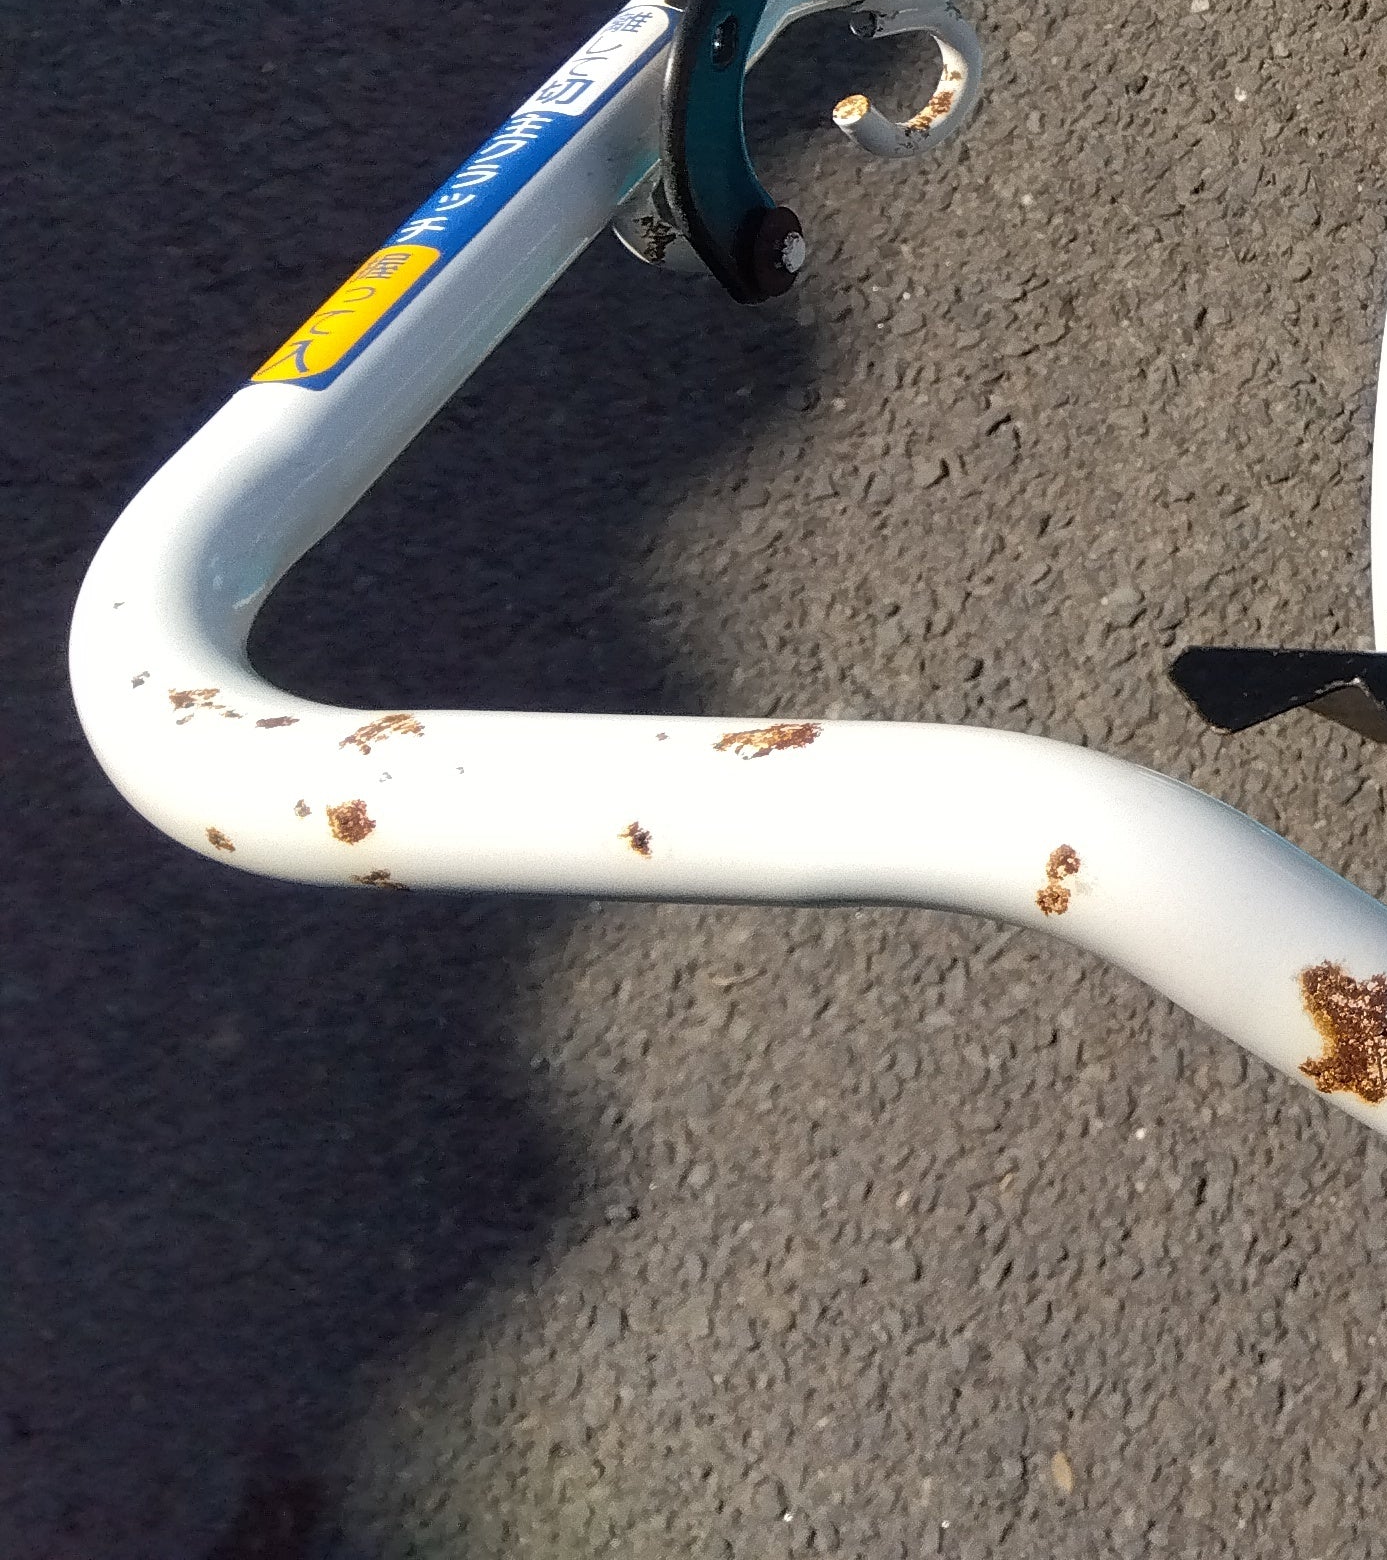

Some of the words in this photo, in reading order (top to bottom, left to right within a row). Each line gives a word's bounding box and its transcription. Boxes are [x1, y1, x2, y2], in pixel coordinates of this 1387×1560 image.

[397, 113, 552, 243] 主クラッチ
